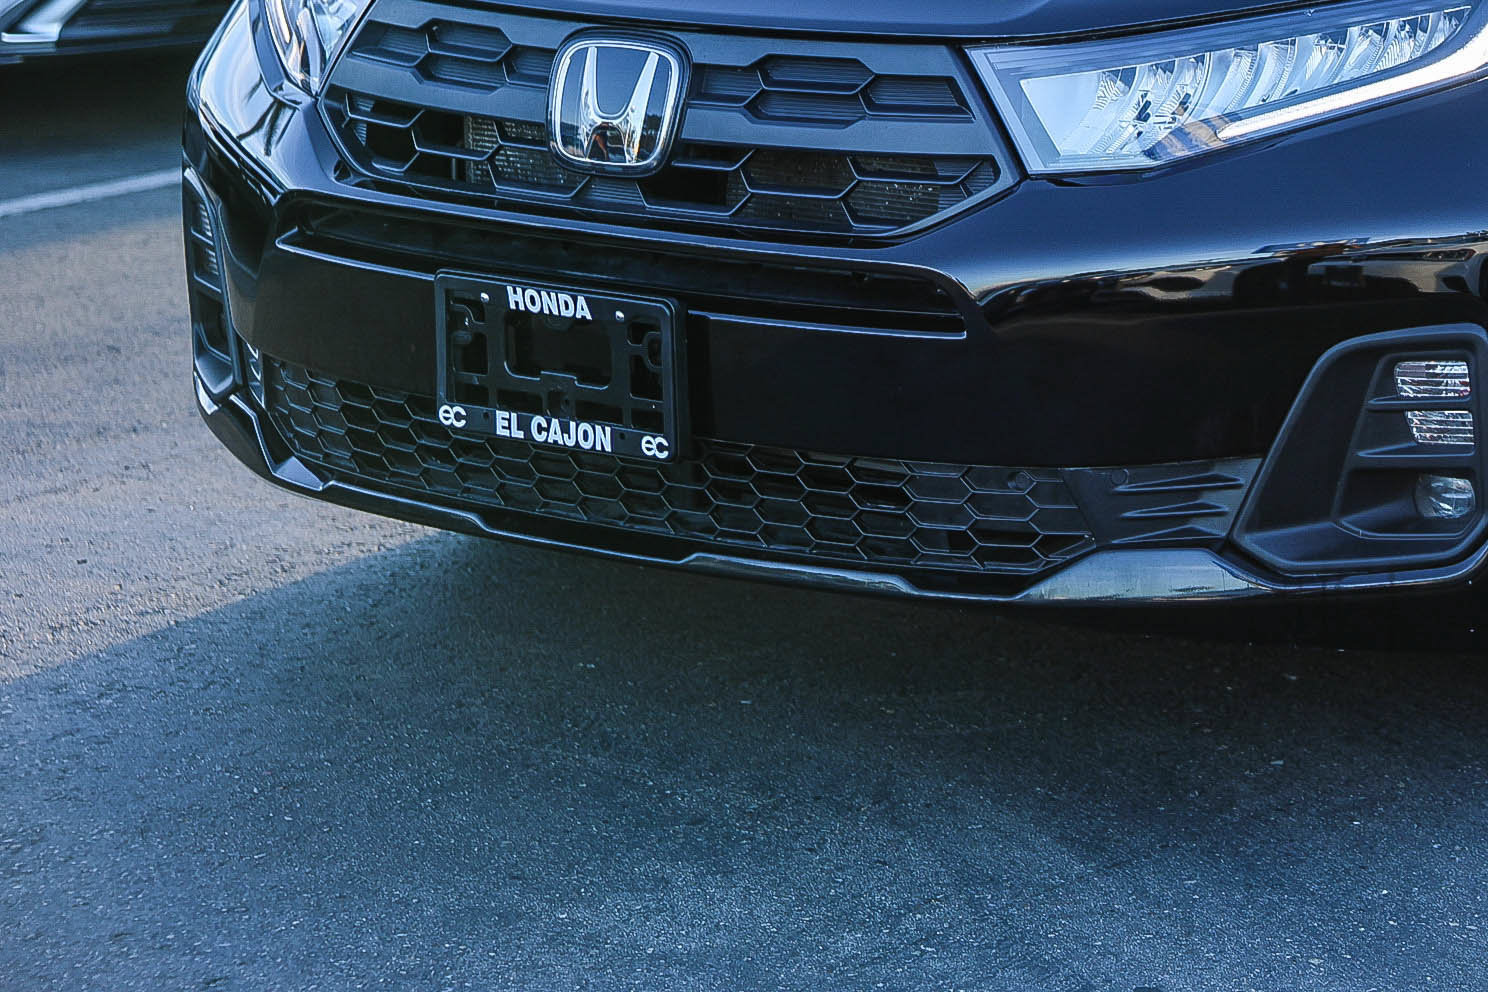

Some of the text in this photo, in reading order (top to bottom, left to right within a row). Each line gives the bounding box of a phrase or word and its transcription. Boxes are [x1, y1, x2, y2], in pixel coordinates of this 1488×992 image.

[506, 285, 592, 321] HONDA
[495, 410, 612, 452] EL CAJON
